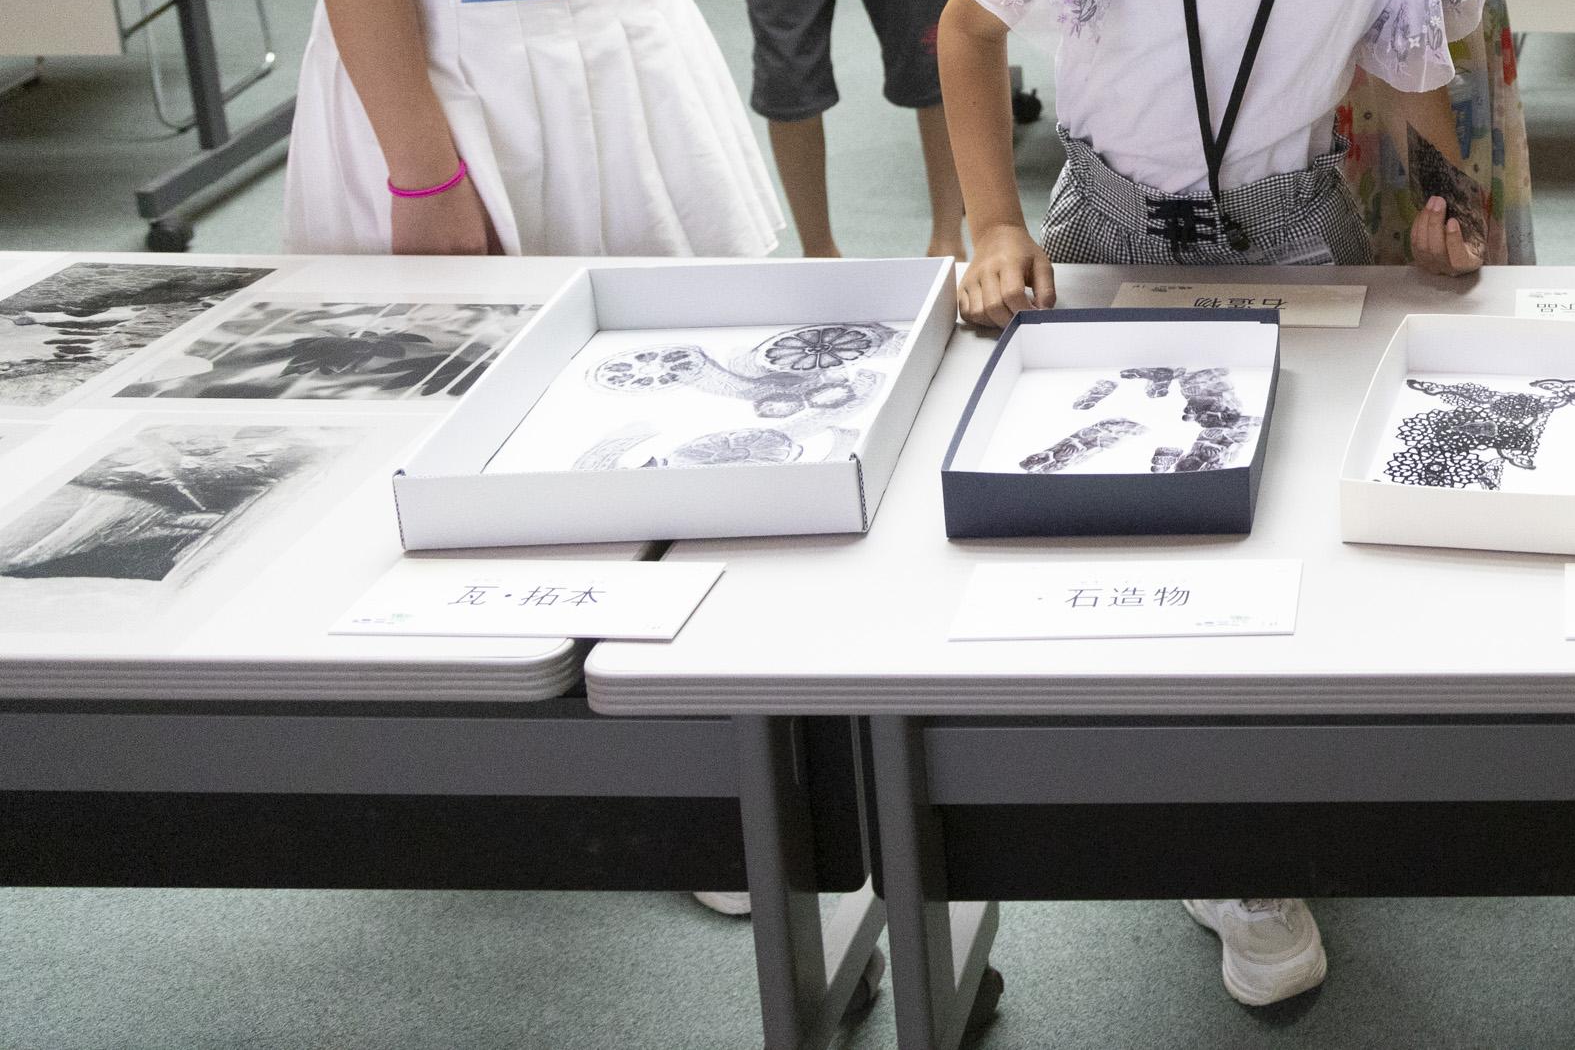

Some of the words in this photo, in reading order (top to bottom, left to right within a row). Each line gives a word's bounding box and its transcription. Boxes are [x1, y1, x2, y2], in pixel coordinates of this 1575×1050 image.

[447, 585, 607, 607] 瓦・拓本
[1065, 586, 1191, 608] 石造物
